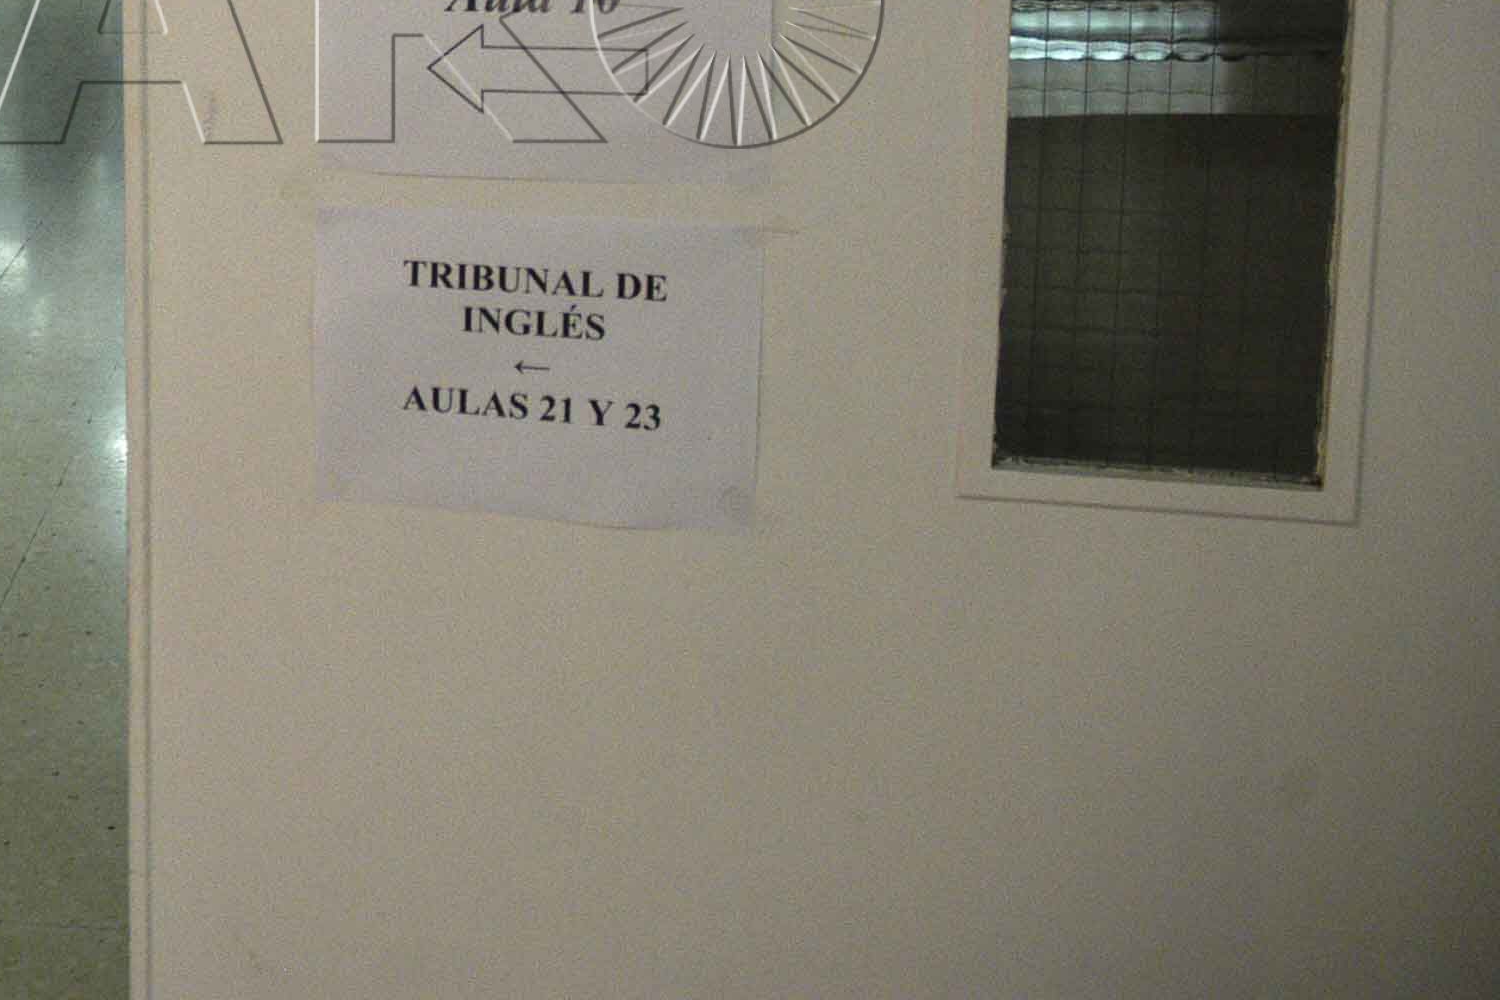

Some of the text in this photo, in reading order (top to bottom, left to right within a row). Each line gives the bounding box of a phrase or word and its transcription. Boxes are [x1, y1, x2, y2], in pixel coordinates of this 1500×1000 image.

[404, 260, 668, 302] TRIBUNAL DE
[462, 305, 606, 341] INGLÉS
[403, 385, 661, 431] AULAS 21 Y 23
